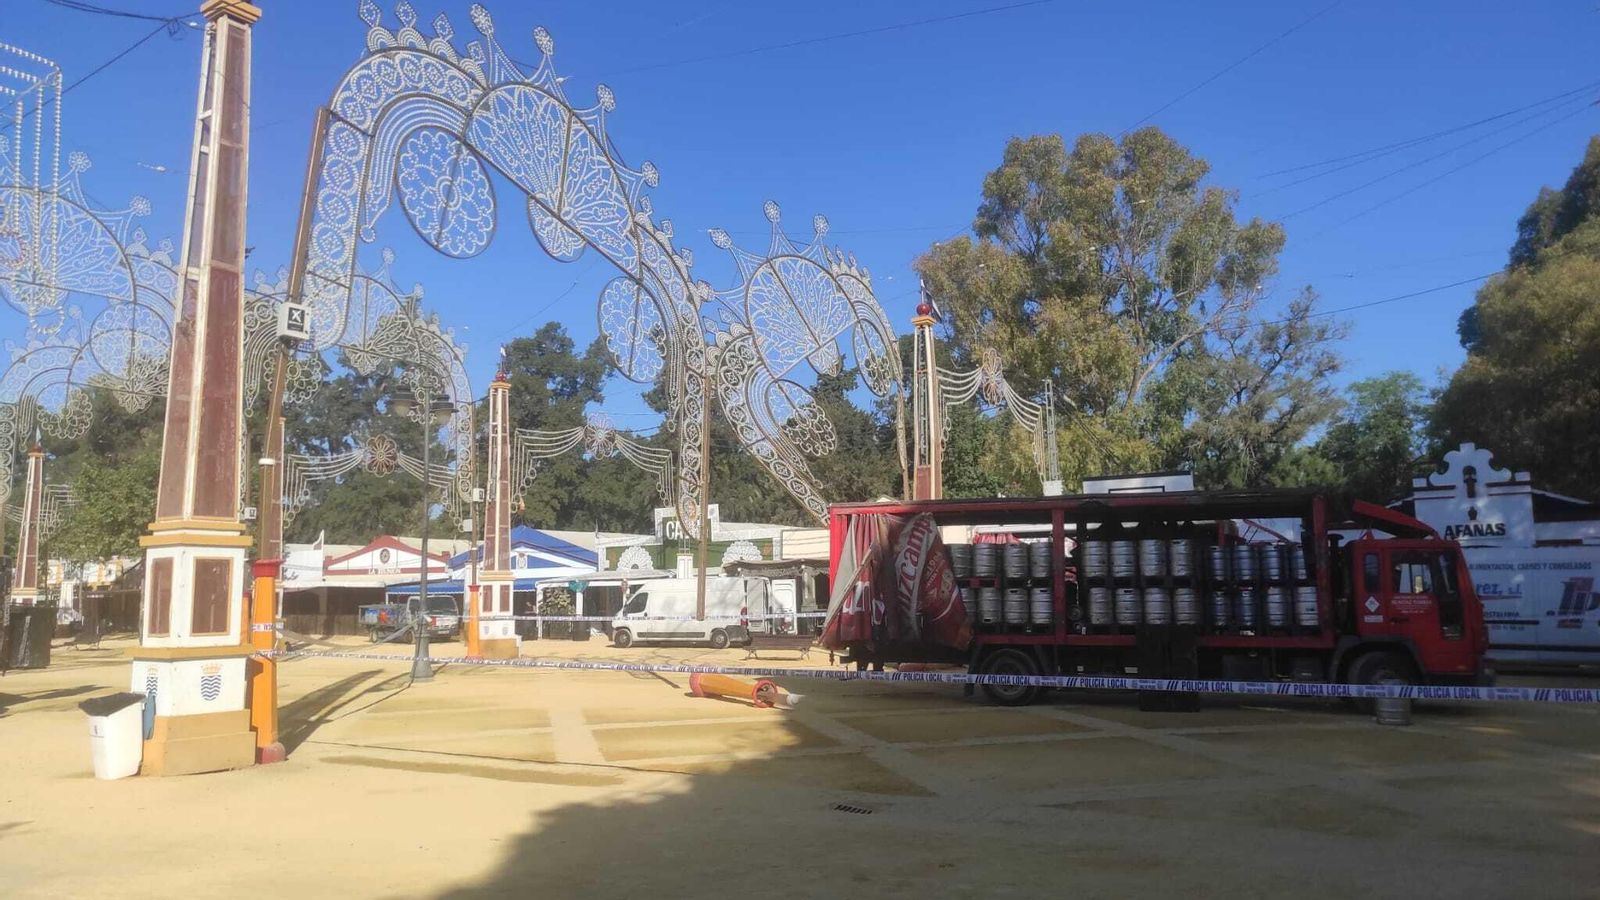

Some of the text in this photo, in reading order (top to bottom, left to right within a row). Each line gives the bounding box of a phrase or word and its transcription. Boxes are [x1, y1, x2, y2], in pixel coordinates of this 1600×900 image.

[1444, 523, 1506, 540] AFANAS
[903, 673, 924, 682] POLICIA
[926, 674, 943, 682] LOCAL
[987, 676, 1010, 685] POLICIA
[1012, 677, 1031, 685] LOCAL
[1080, 678, 1105, 688] POLICIA
[1107, 679, 1128, 689] LOCAL
[1181, 681, 1234, 692] POLICIA LOCAL
[1294, 684, 1351, 695] POLICIA LOCAL
[1417, 687, 1481, 698] POLICIA LOCAL
[1555, 689, 1593, 702] POLICIA
